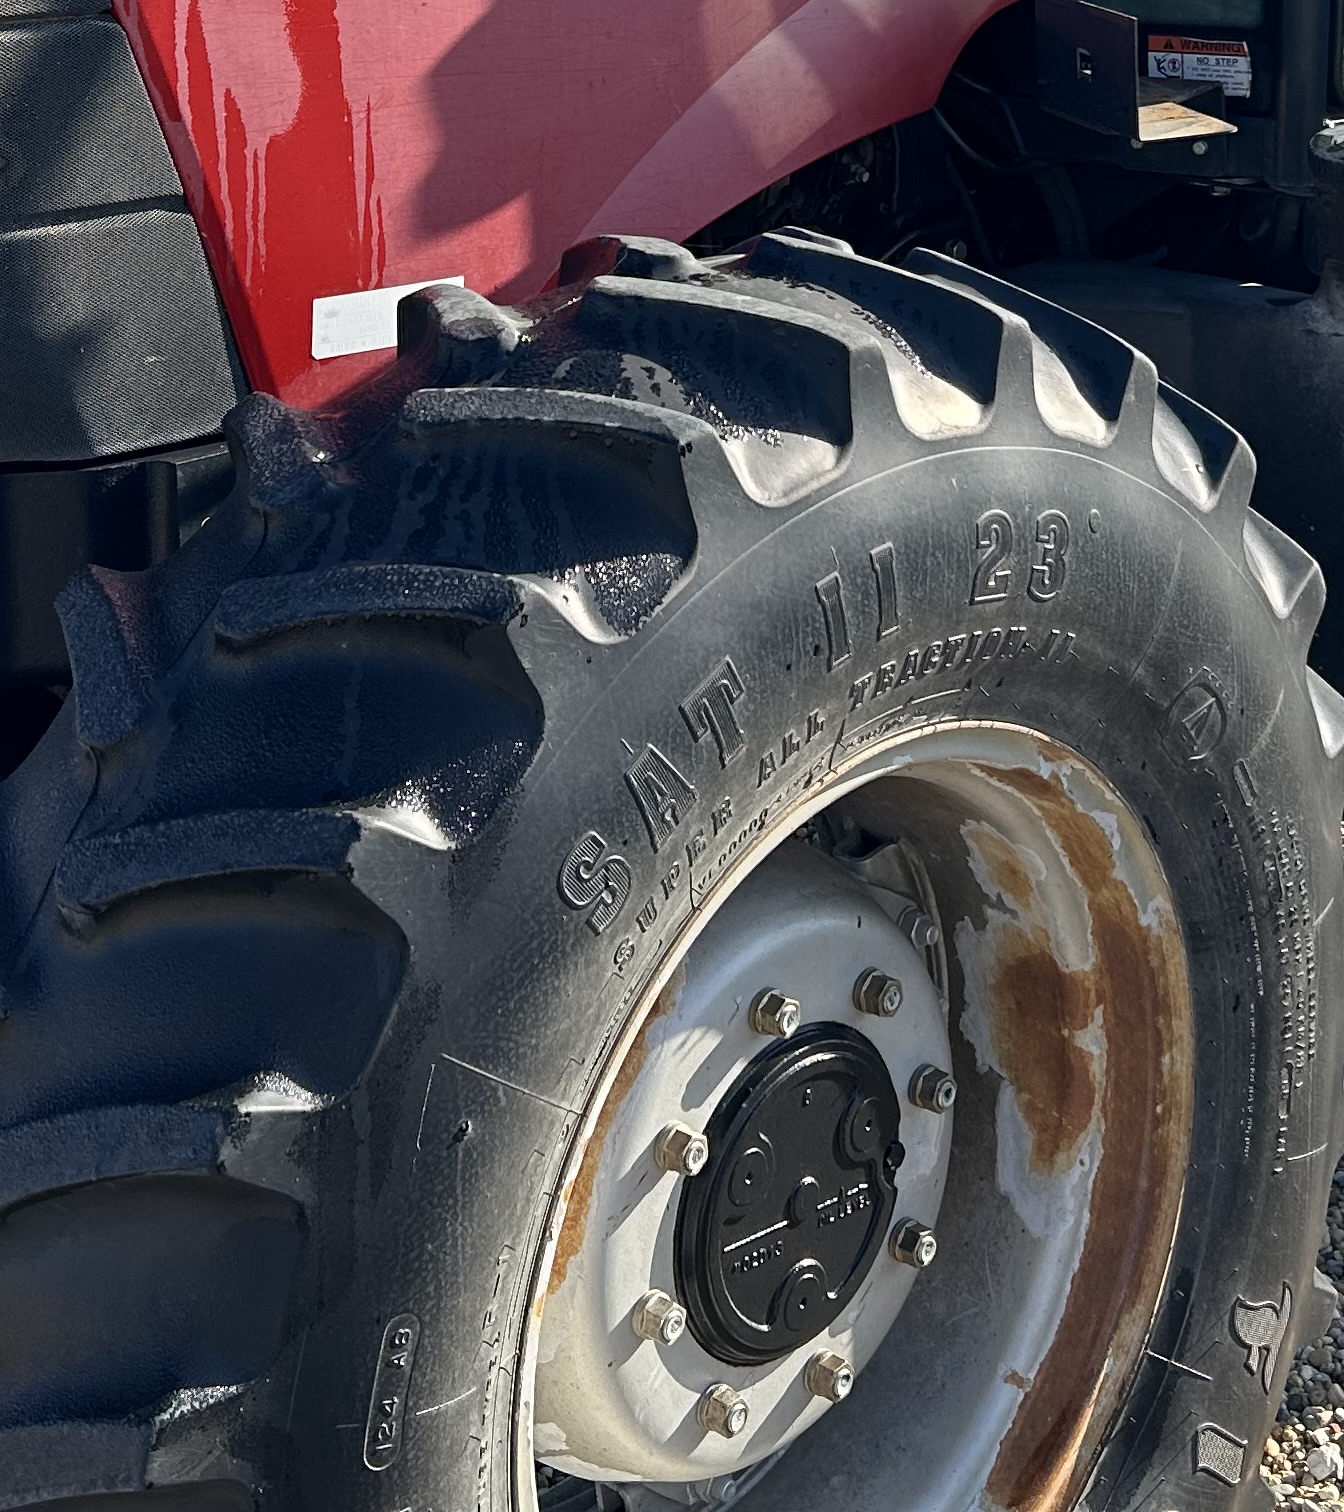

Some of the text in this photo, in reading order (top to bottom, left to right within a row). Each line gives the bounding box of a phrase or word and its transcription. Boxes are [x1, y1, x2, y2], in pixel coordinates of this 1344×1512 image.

[1179, 39, 1241, 53] WARNING
[1196, 56, 1239, 67] NO STEP
[558, 653, 748, 937] SAT
